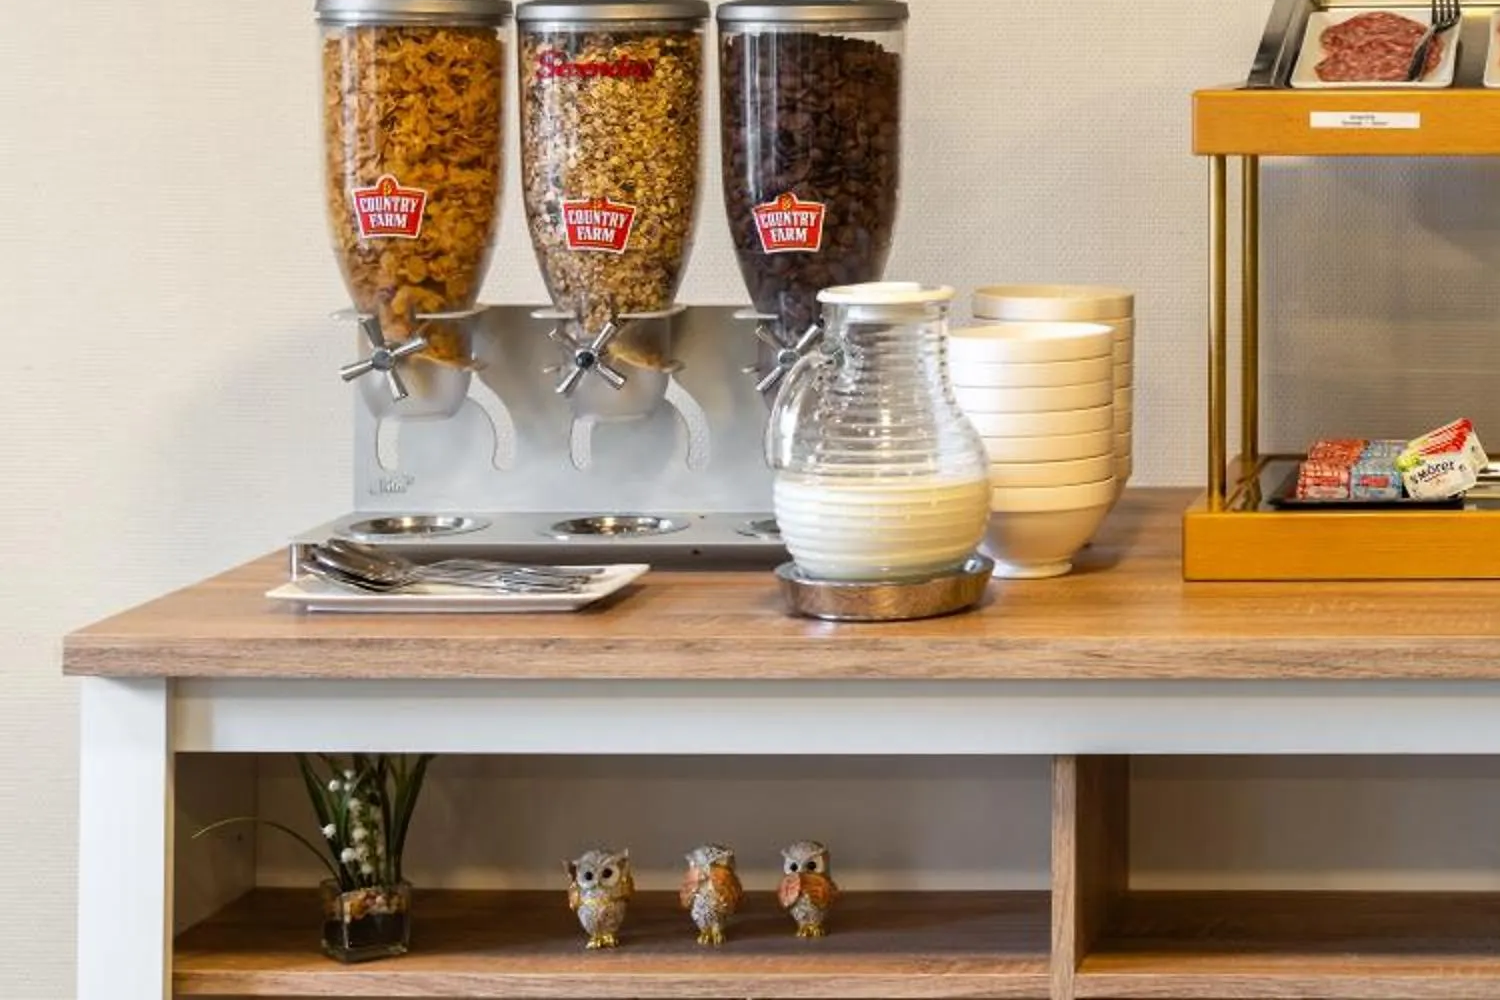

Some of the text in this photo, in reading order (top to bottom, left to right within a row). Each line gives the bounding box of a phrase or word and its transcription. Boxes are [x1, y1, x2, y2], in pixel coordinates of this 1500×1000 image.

[360, 196, 419, 213] COUNTRY
[368, 213, 408, 229] FARM
[568, 209, 629, 229] COUNTRY
[759, 210, 820, 229] COUNTRY
[576, 225, 616, 243] FARM
[769, 227, 808, 243] FARM
